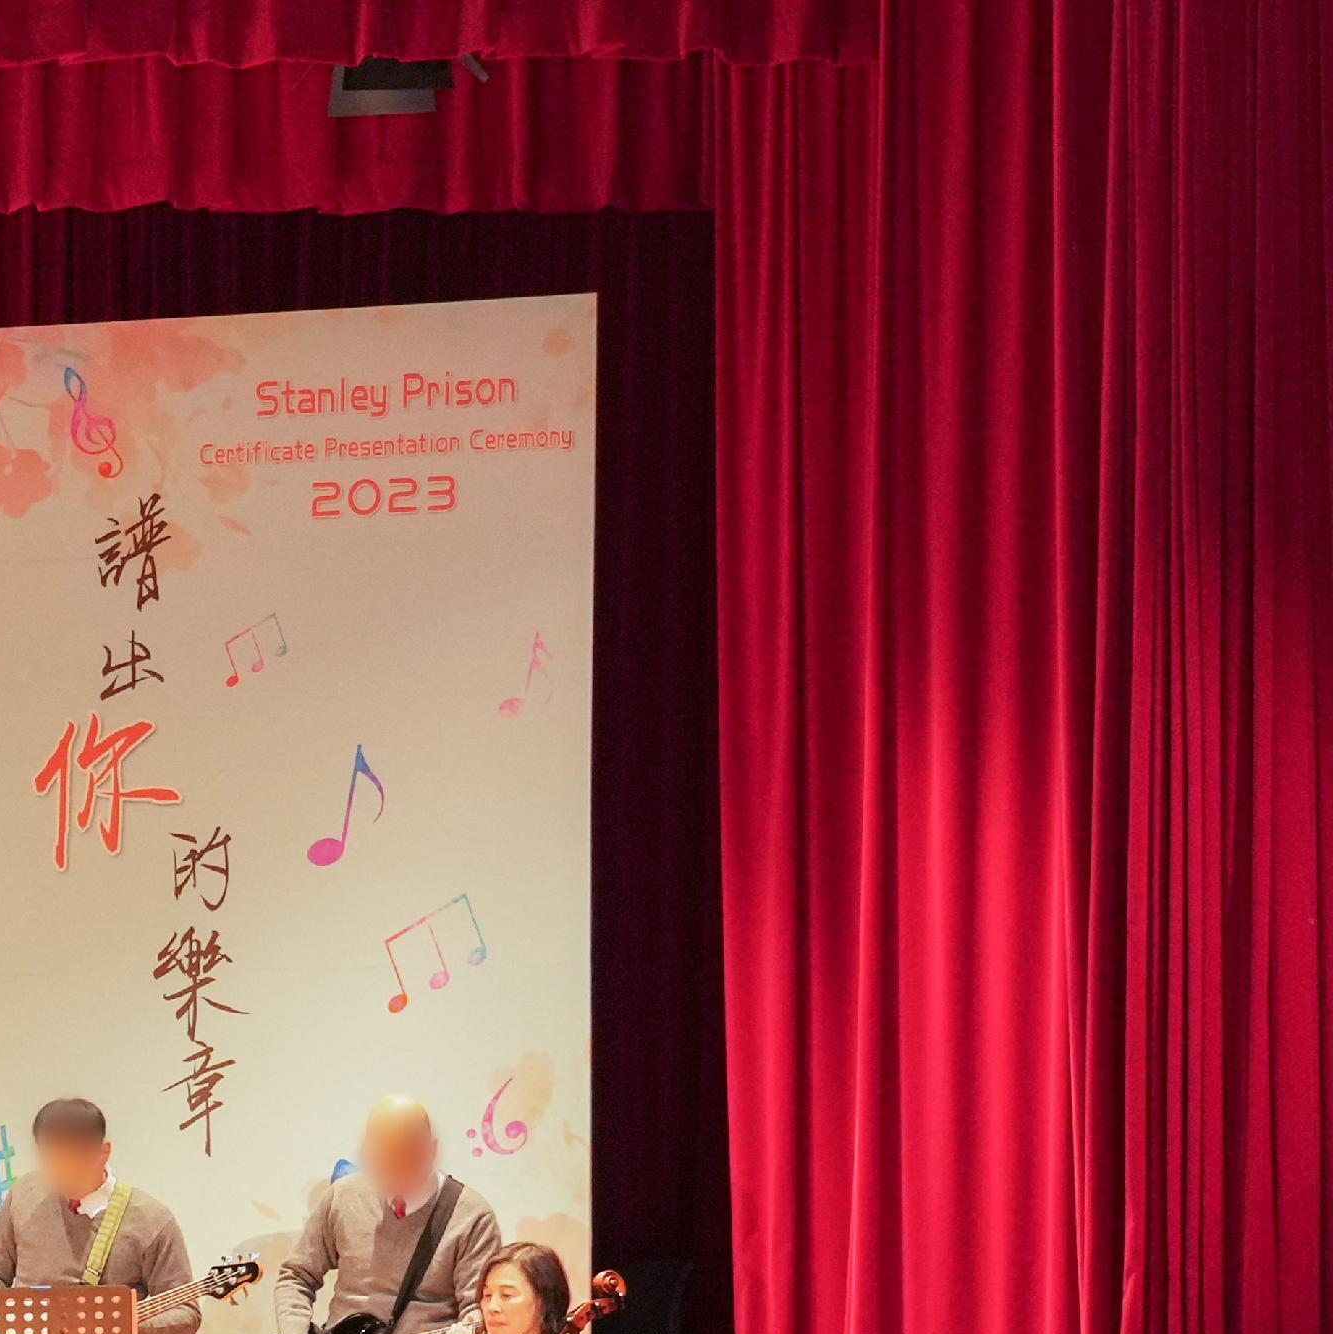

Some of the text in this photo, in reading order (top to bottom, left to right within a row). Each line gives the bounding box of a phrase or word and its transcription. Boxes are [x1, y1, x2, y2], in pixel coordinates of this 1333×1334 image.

[255, 371, 518, 419] Stanley Prison
[199, 428, 574, 465] Certificate Presentation Ceremony
[311, 475, 457, 518] 2023
[33, 493, 250, 1157] 譜出你的樂章
